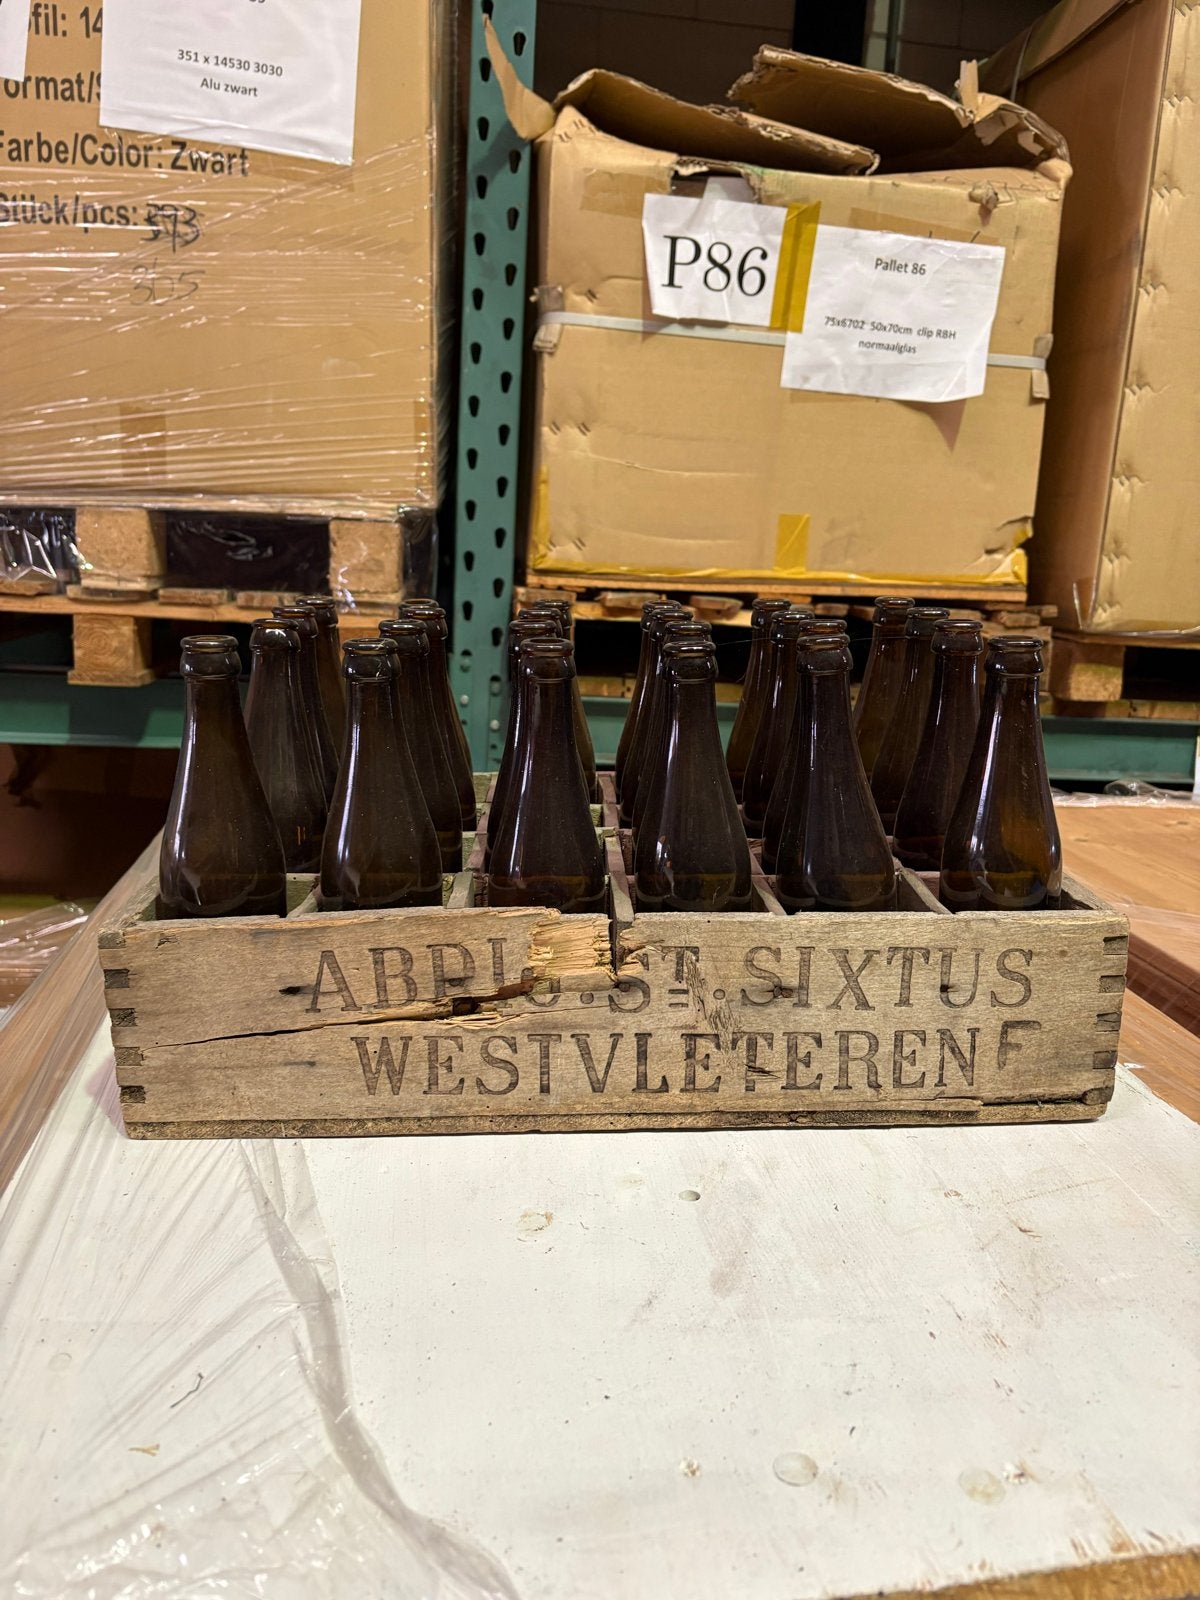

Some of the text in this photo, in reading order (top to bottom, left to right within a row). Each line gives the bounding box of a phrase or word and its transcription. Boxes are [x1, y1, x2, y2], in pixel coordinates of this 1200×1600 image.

[28, 3, 67, 37] fil:
[178, 49, 283, 77] 351 x 14530 3030
[200, 78, 258, 97] Alu zwart
[171, 139, 248, 177] Zwart
[660, 234, 768, 297] P86
[874, 257, 927, 276] Pallet 86
[870, 321, 913, 335] 50x70cm
[916, 327, 935, 339] clip
[741, 946, 1032, 1010] SIXTUS
[350, 1027, 980, 1096] WESTVLETEREN
